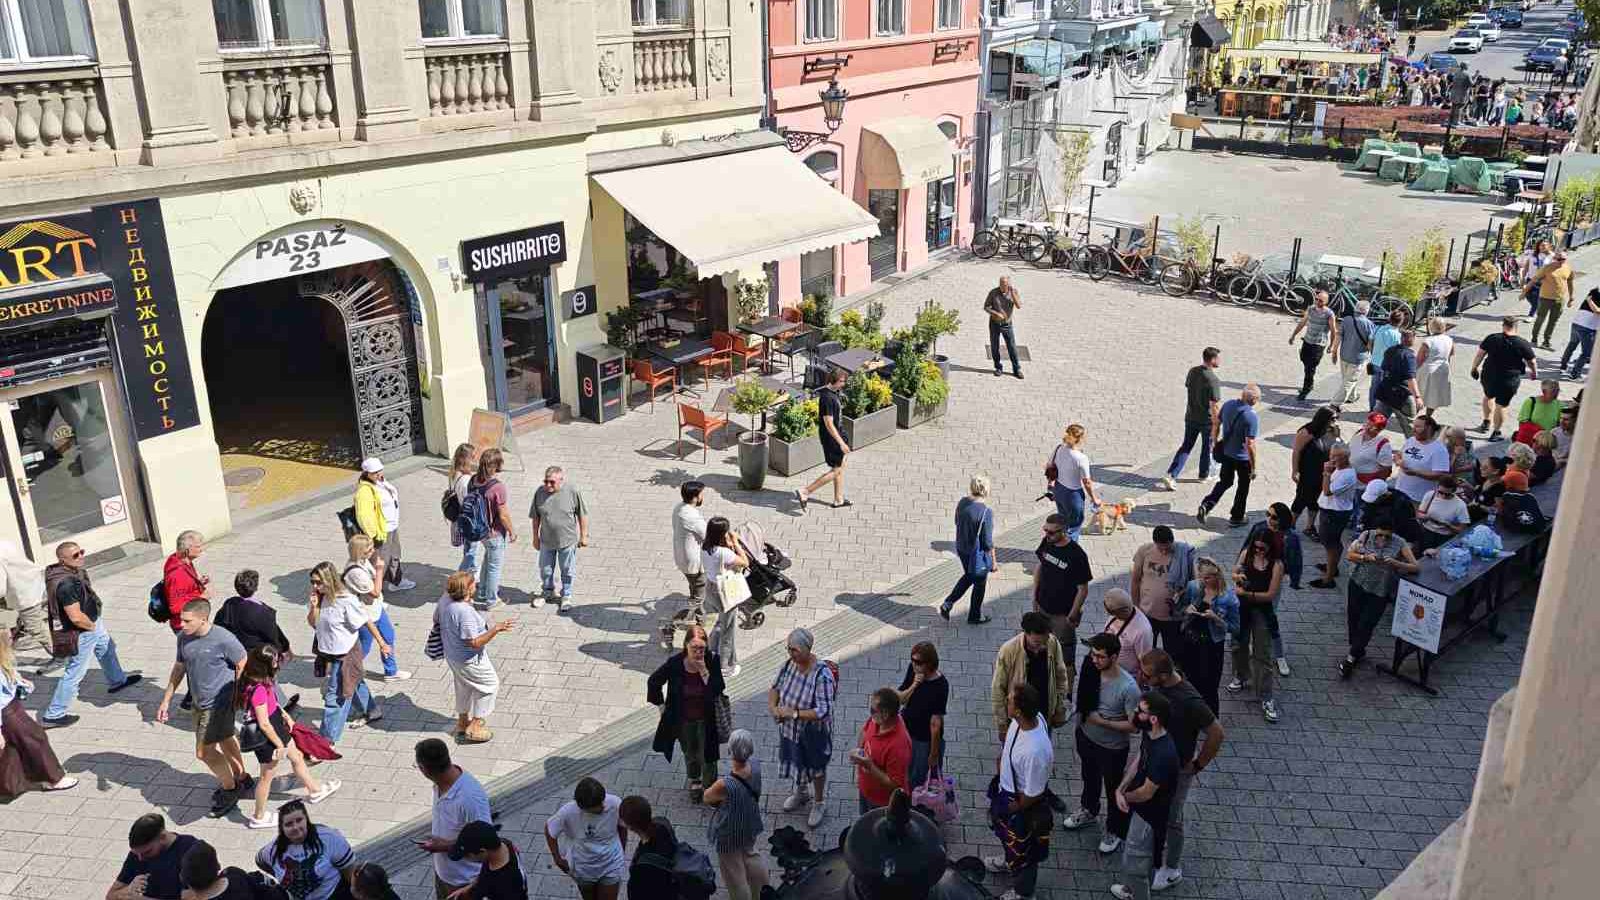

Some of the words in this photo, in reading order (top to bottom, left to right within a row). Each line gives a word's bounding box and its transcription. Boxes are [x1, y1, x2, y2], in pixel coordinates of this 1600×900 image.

[255, 223, 347, 260] PASAŽ
[289, 251, 321, 272] 23
[119, 208, 176, 430] НЕДВИЖИМОСТЬ
